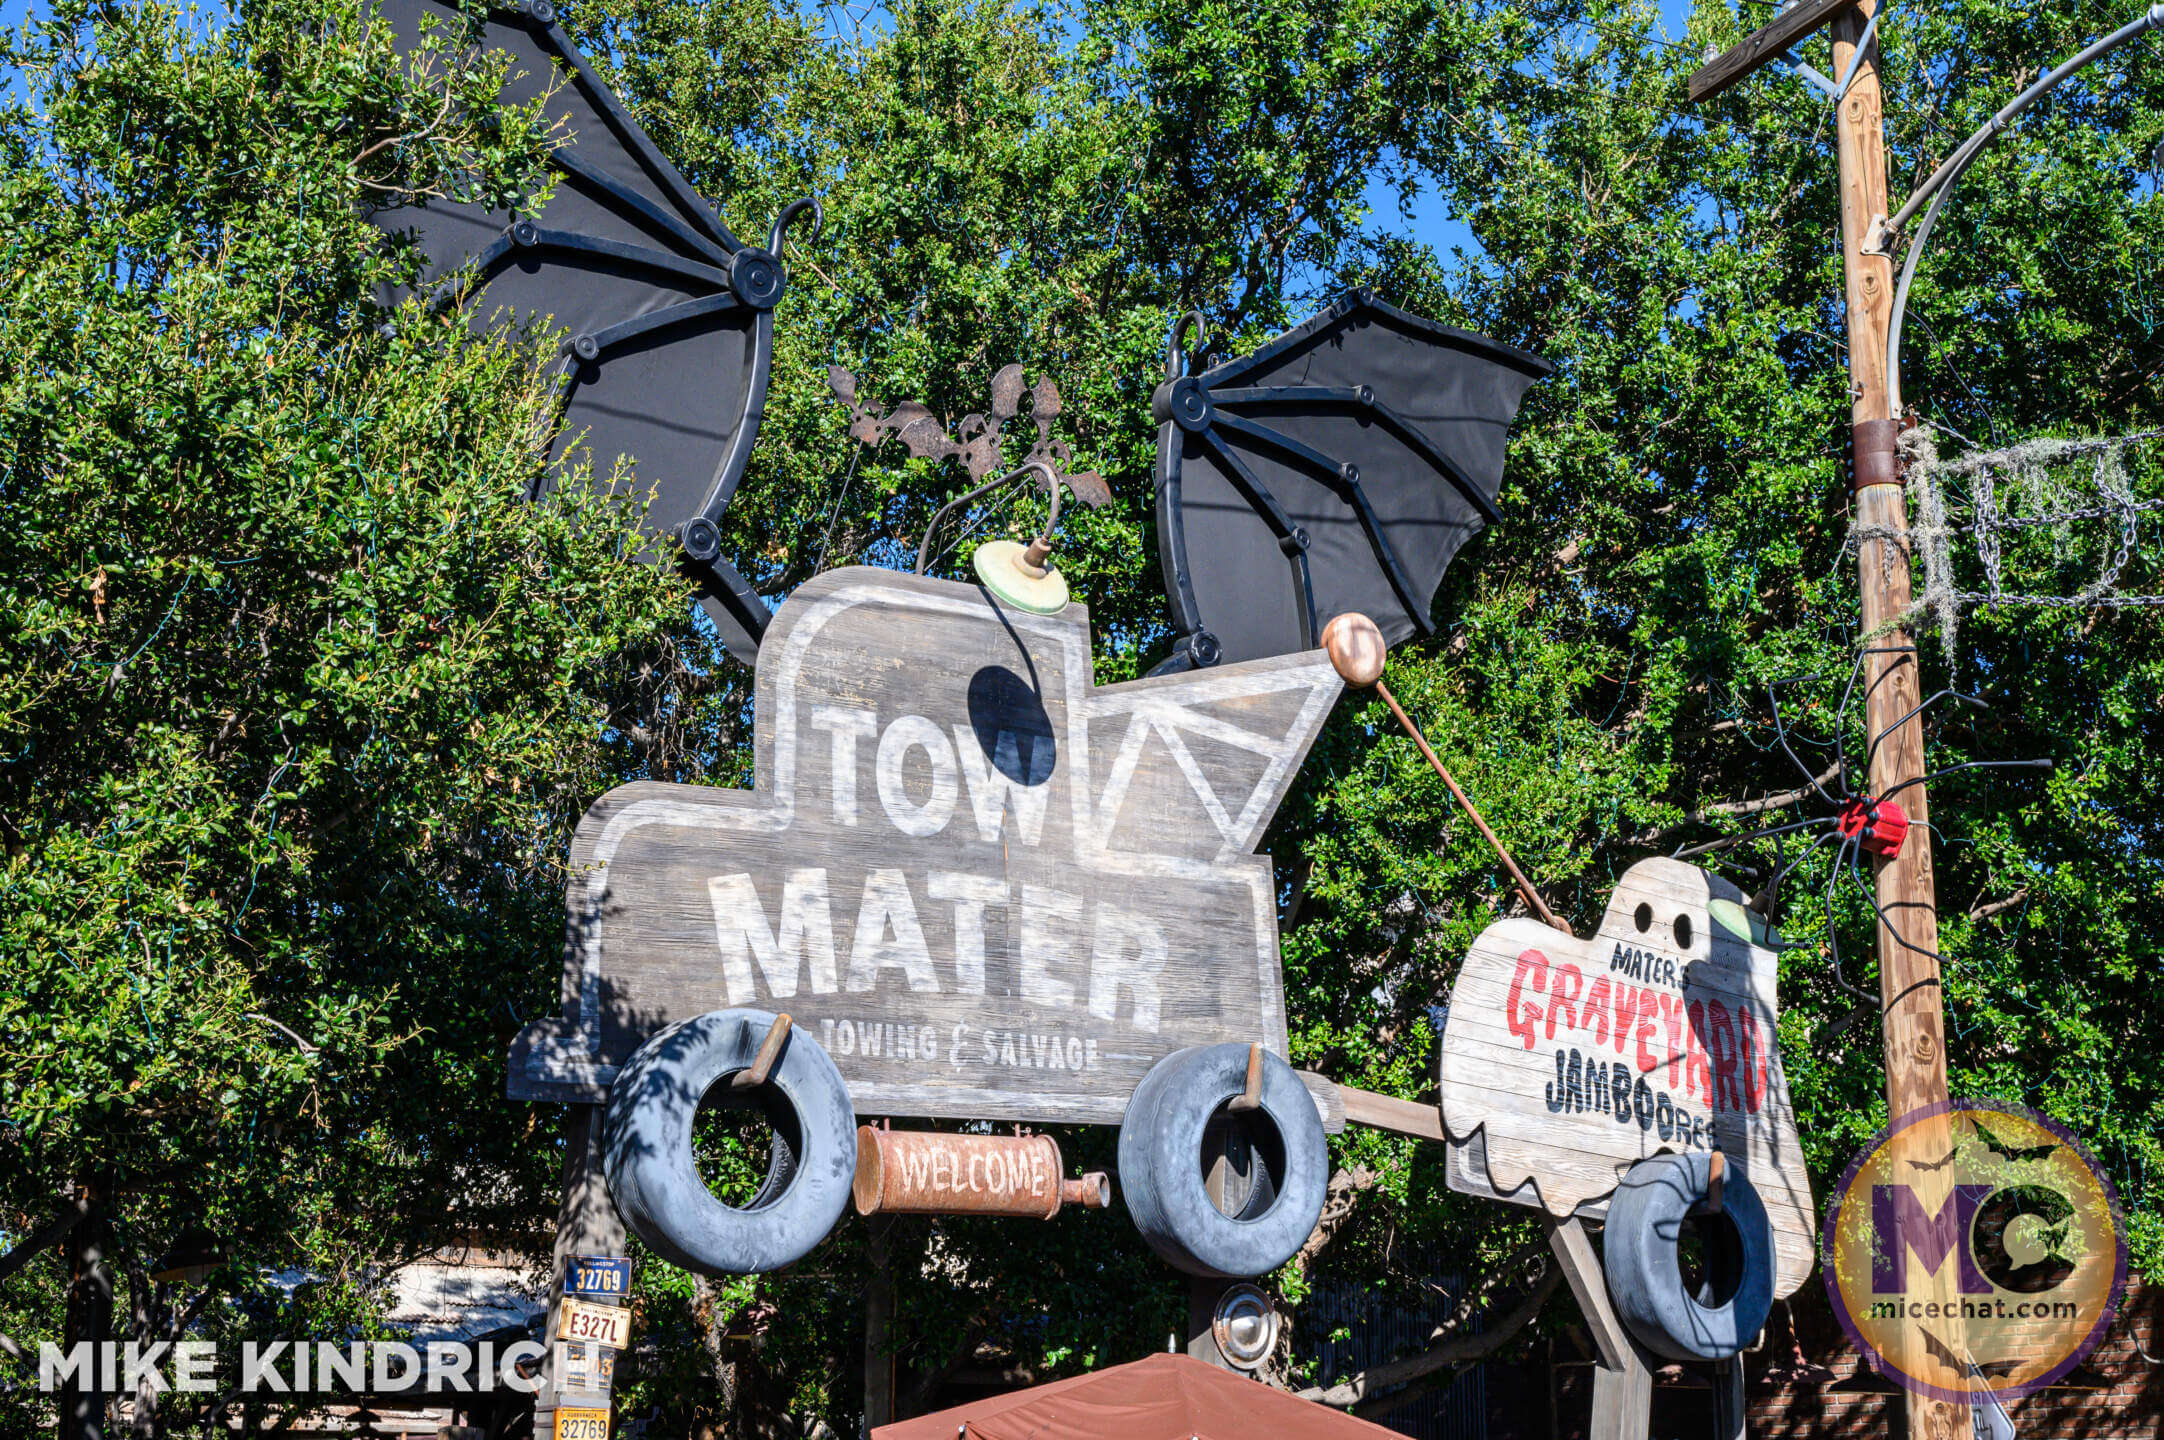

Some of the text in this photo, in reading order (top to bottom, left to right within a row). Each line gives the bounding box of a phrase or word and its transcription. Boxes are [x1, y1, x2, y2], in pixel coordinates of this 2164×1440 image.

[811, 705, 1055, 847] TOW
[707, 868, 1169, 1034] MATER
[1610, 942, 1690, 991] MATER'S
[819, 1018, 1098, 1072] TOWING & SALVAGE
[1506, 949, 1767, 1115] GRAVEYARD
[893, 1145, 1045, 1198] WELCOME
[576, 1267, 621, 1291] 32769
[569, 1313, 617, 1342] E327L
[560, 1419, 607, 1439] 32769
